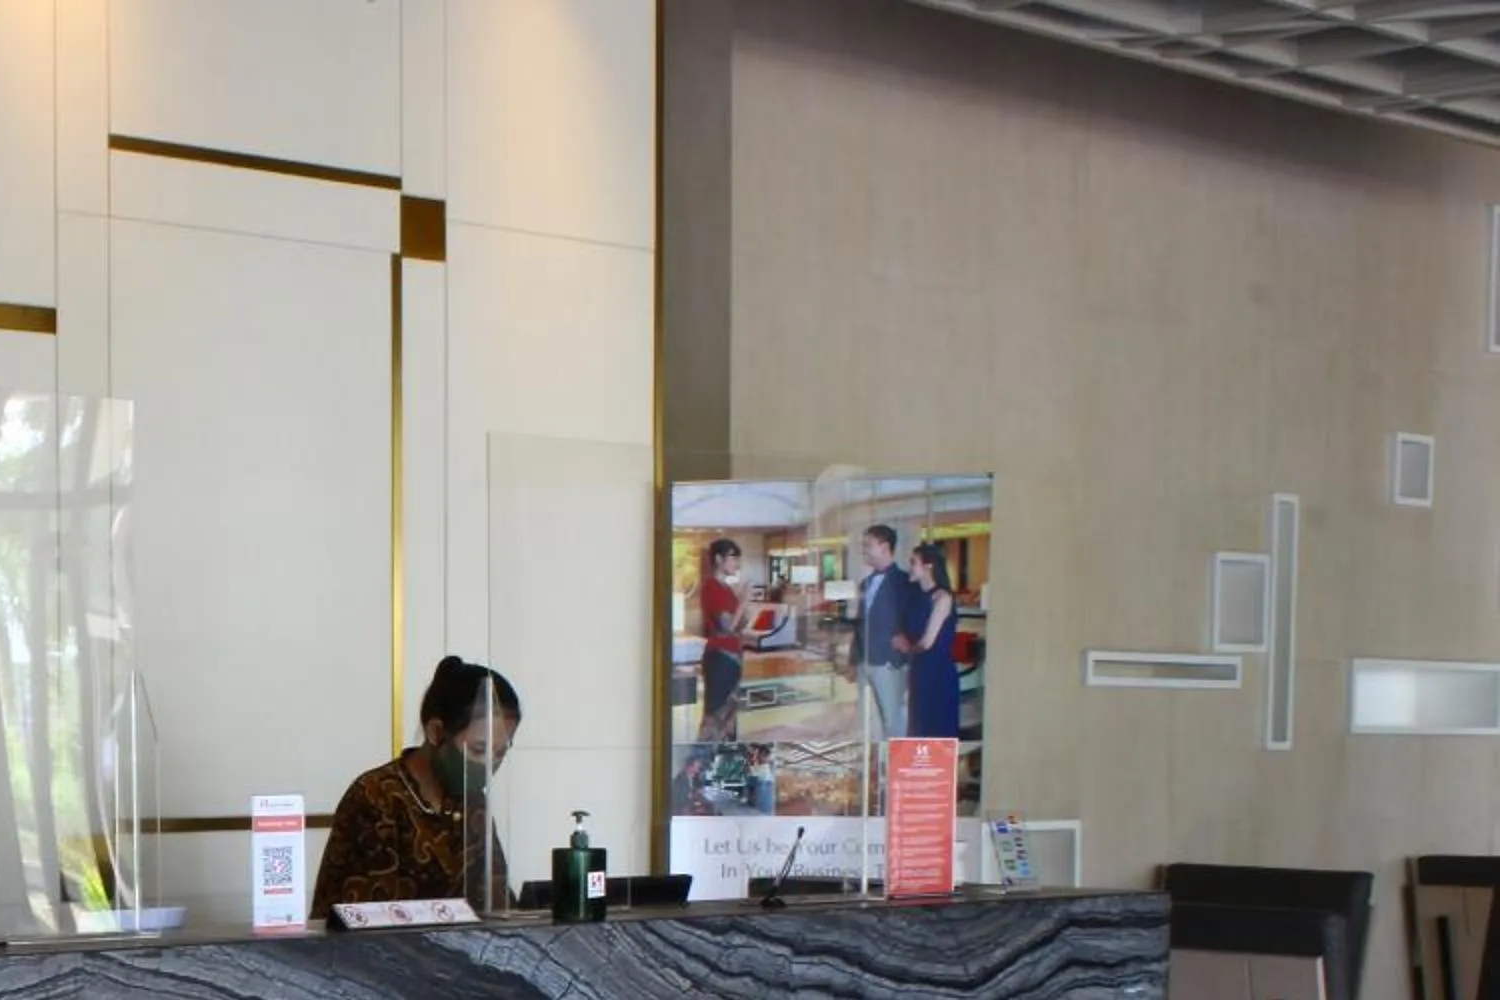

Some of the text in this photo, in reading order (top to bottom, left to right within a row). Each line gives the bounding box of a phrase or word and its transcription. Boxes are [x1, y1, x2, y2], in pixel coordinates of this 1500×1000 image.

[704, 837, 731, 855] Let
[736, 837, 762, 855] Us
[841, 837, 886, 856] Com
[720, 862, 738, 879] In
